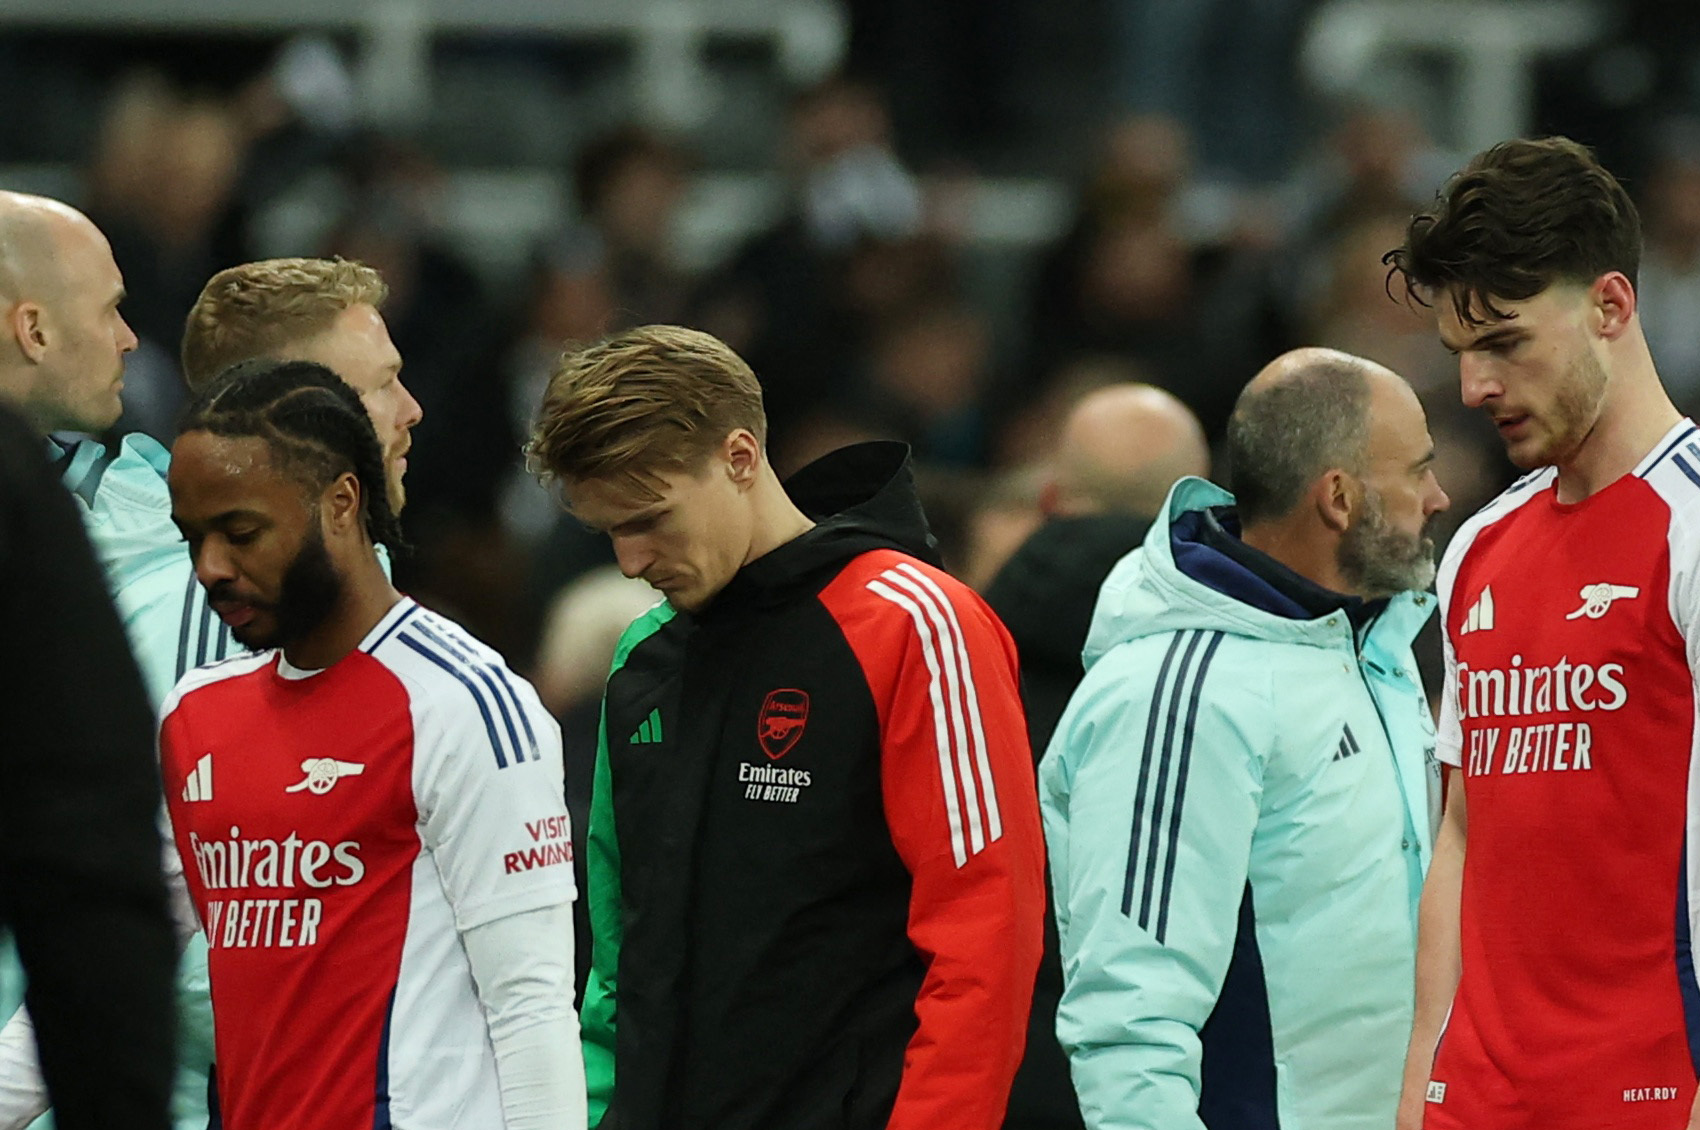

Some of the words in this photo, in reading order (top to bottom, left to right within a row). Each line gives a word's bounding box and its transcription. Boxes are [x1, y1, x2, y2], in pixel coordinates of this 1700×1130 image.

[1456, 654, 1627, 721] Emirates
[1468, 727, 1500, 777] FLY
[1502, 723, 1592, 774] BETTER
[739, 762, 811, 787] Emirates
[745, 784, 763, 800] FLY
[763, 785, 800, 803] BETTER
[525, 815, 567, 842] VISIT
[504, 841, 573, 875] RWAND
[223, 899, 322, 948] BETTER
[1623, 1087, 1677, 1102] HEAT.RDY
